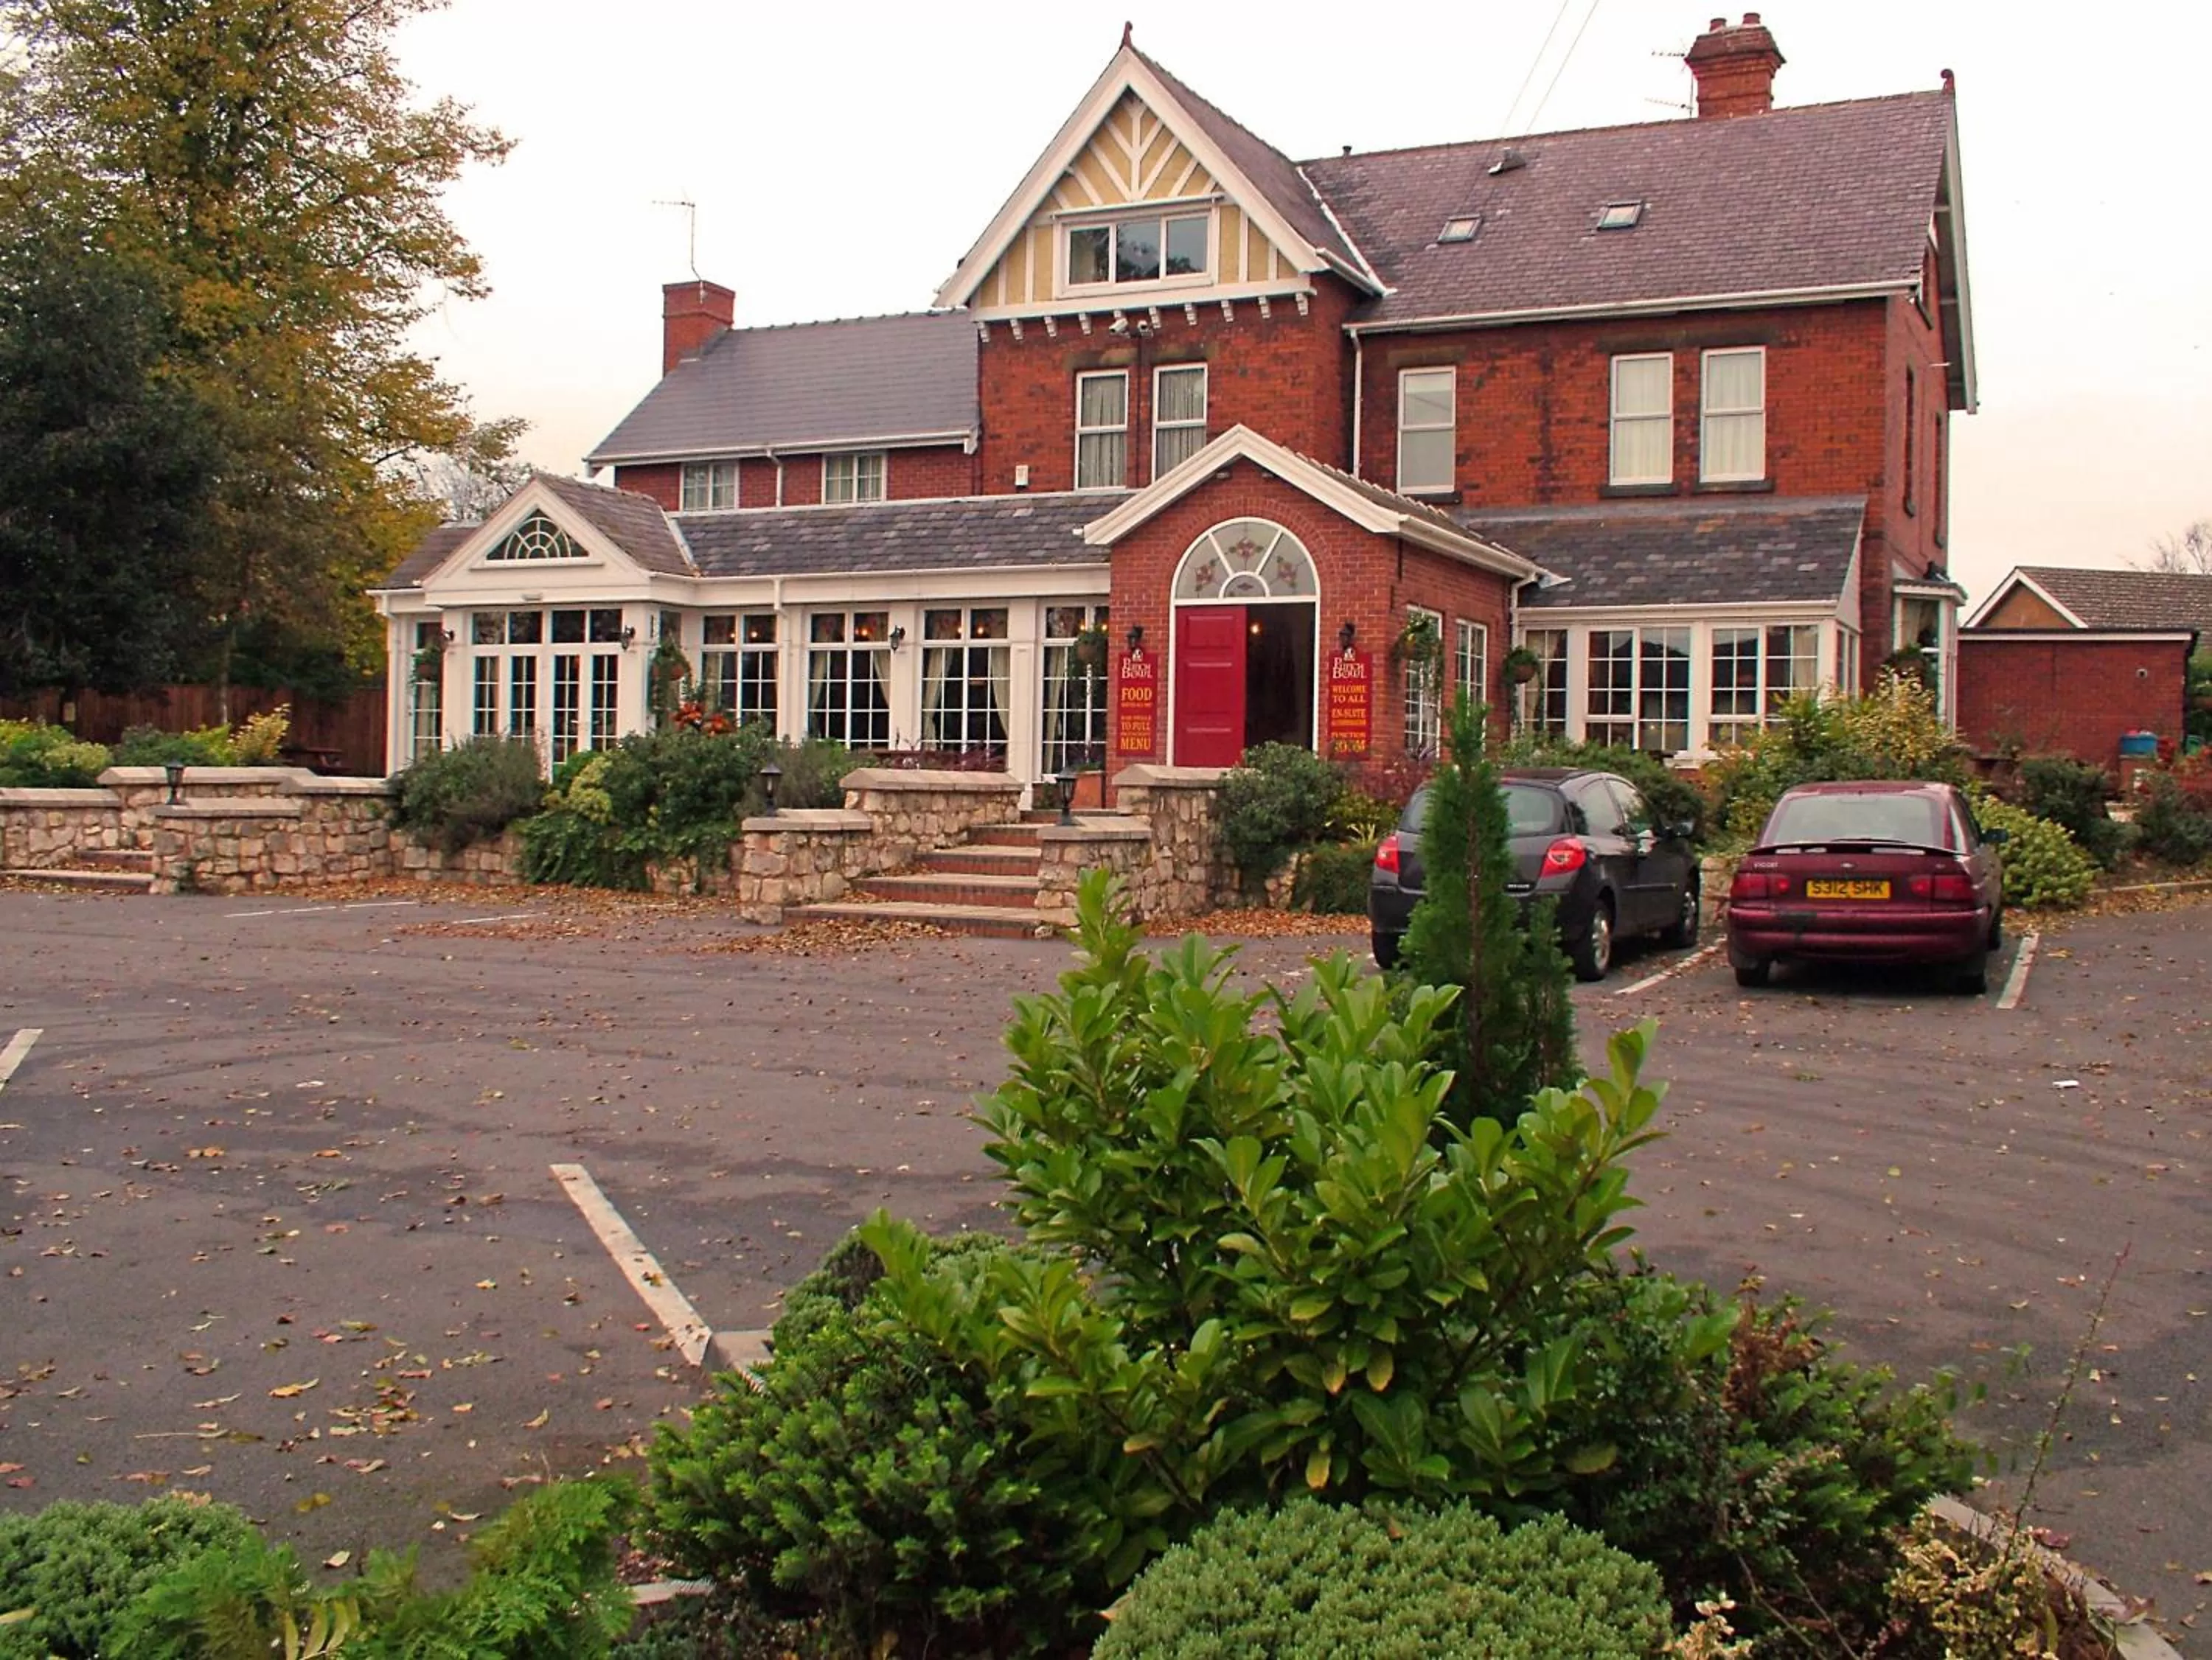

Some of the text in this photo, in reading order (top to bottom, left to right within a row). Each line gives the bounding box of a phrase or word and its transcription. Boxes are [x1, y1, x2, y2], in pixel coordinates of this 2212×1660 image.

[1121, 687, 1152, 701] FOOD
[1332, 685, 1366, 694] WELCOME
[1332, 695, 1366, 703] TO ALL
[1121, 722, 1132, 730] TO
[1121, 736, 1151, 750] MENU
